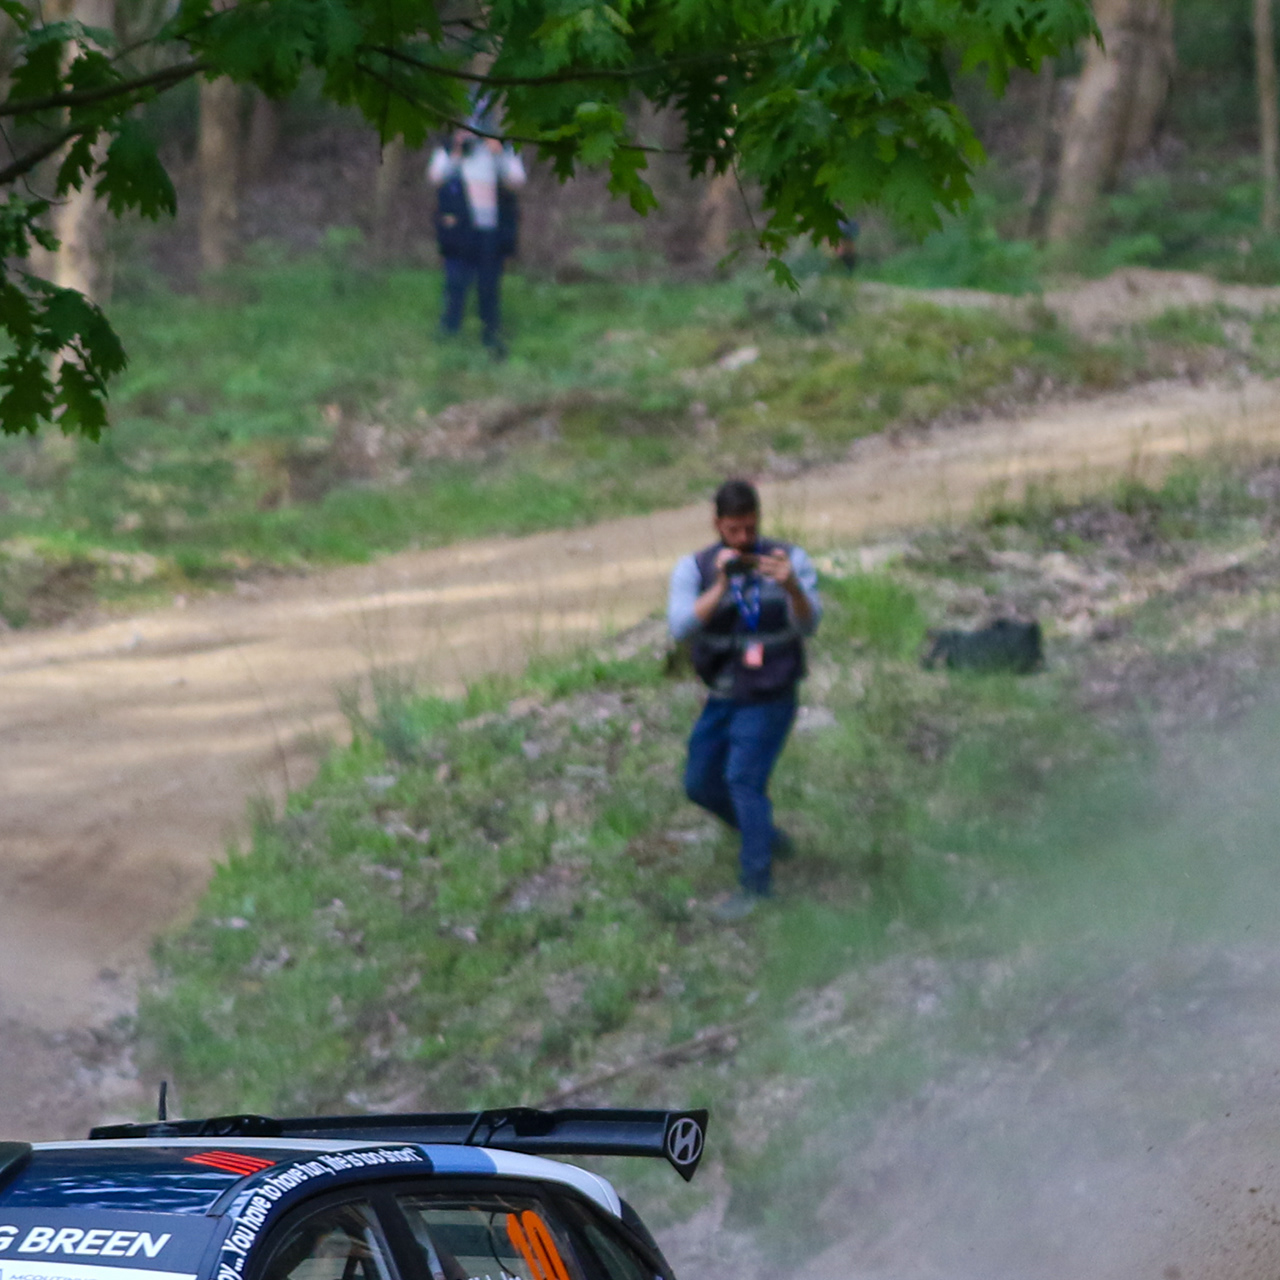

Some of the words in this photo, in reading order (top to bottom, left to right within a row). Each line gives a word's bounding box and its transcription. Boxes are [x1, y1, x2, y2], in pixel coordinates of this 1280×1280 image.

[253, 1184, 283, 1201] to
[263, 1167, 309, 1193] have
[233, 1195, 272, 1232] have
[17, 1225, 172, 1258] BREEN
